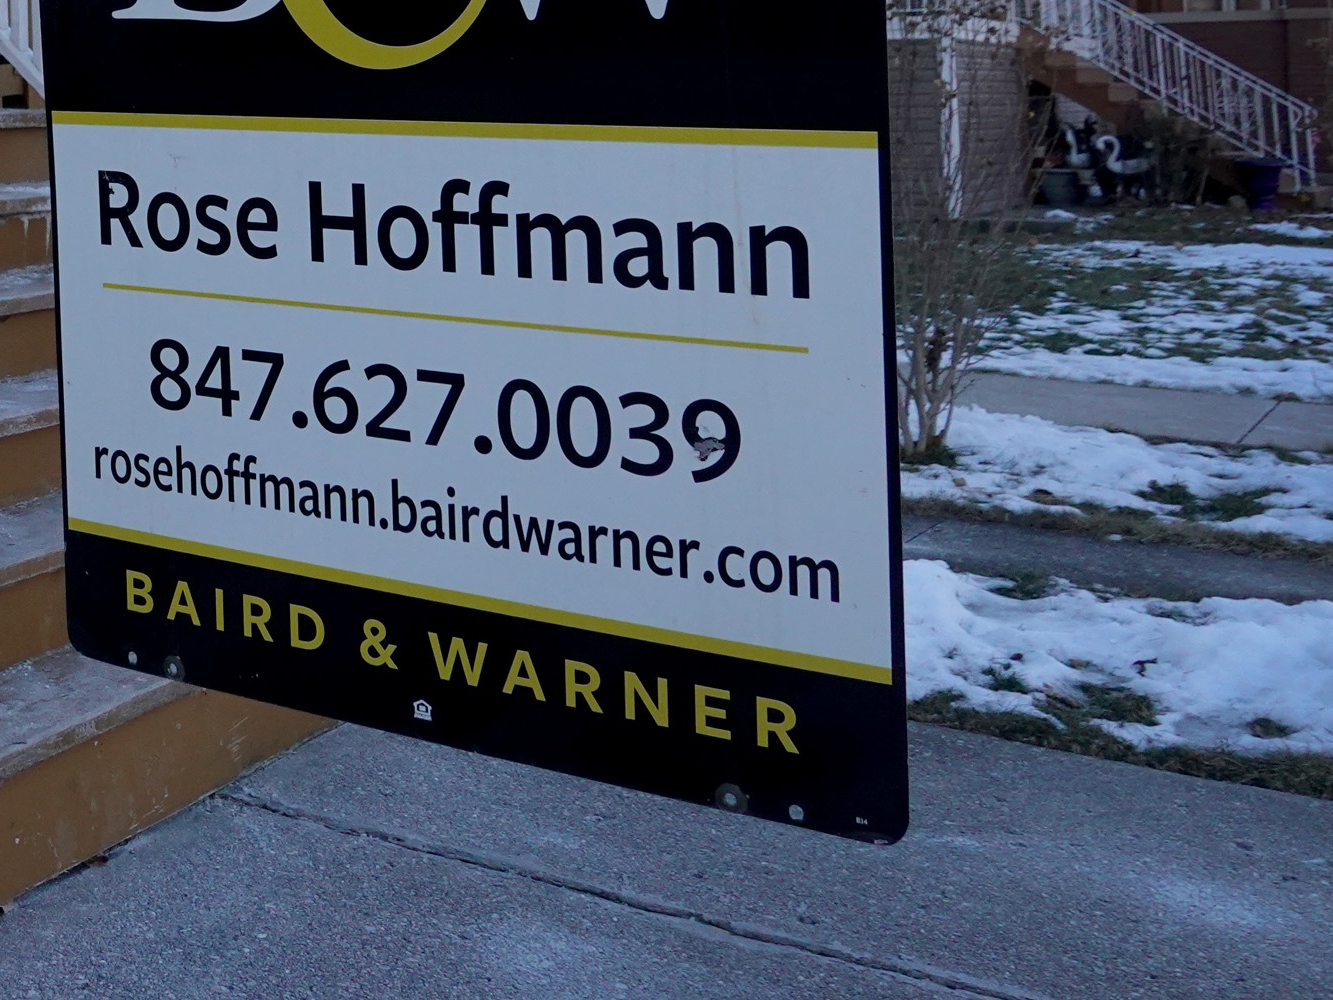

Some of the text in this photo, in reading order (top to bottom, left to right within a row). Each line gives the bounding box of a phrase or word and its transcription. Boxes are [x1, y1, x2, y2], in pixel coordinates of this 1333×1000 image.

[97, 169, 811, 300] Rose Hoffmann
[149, 338, 742, 484] 847.627.0039
[94, 444, 841, 604] rosehoffmann.bairdwarner.com
[125, 570, 800, 754] BAIRD & WARNER
